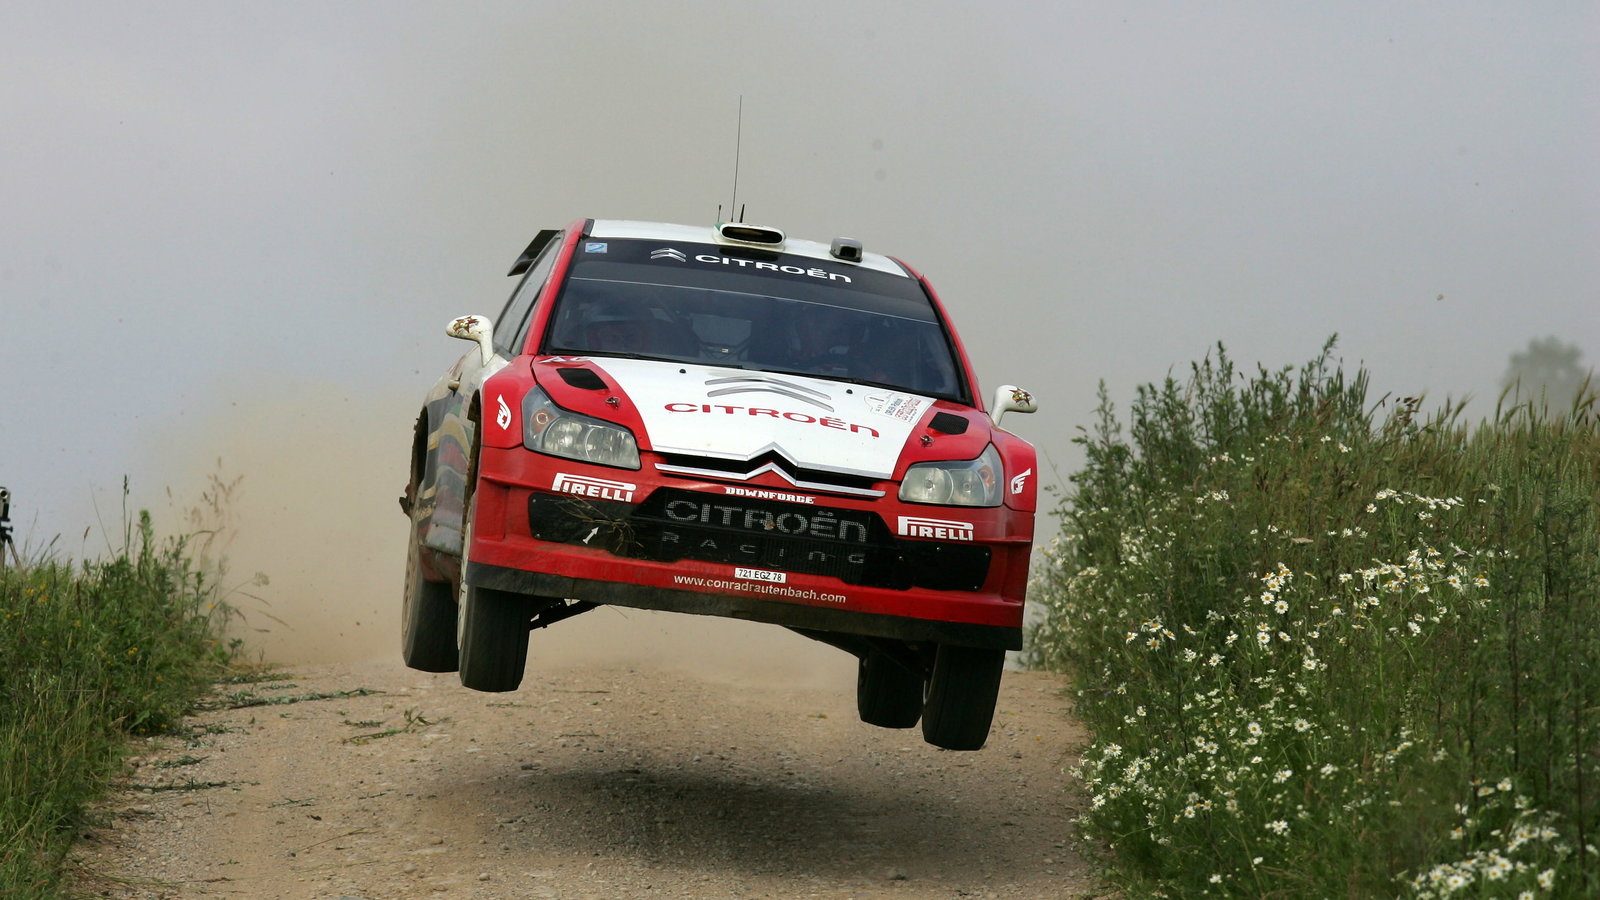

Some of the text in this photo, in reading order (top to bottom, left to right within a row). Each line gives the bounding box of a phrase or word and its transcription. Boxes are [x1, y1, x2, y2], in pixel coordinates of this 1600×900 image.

[551, 472, 637, 503] PIRELLI
[897, 515, 974, 541] PIRELLI
[673, 574, 847, 604] www.conradrautenbach.com
[739, 569, 782, 581] 721 EGZ 78
